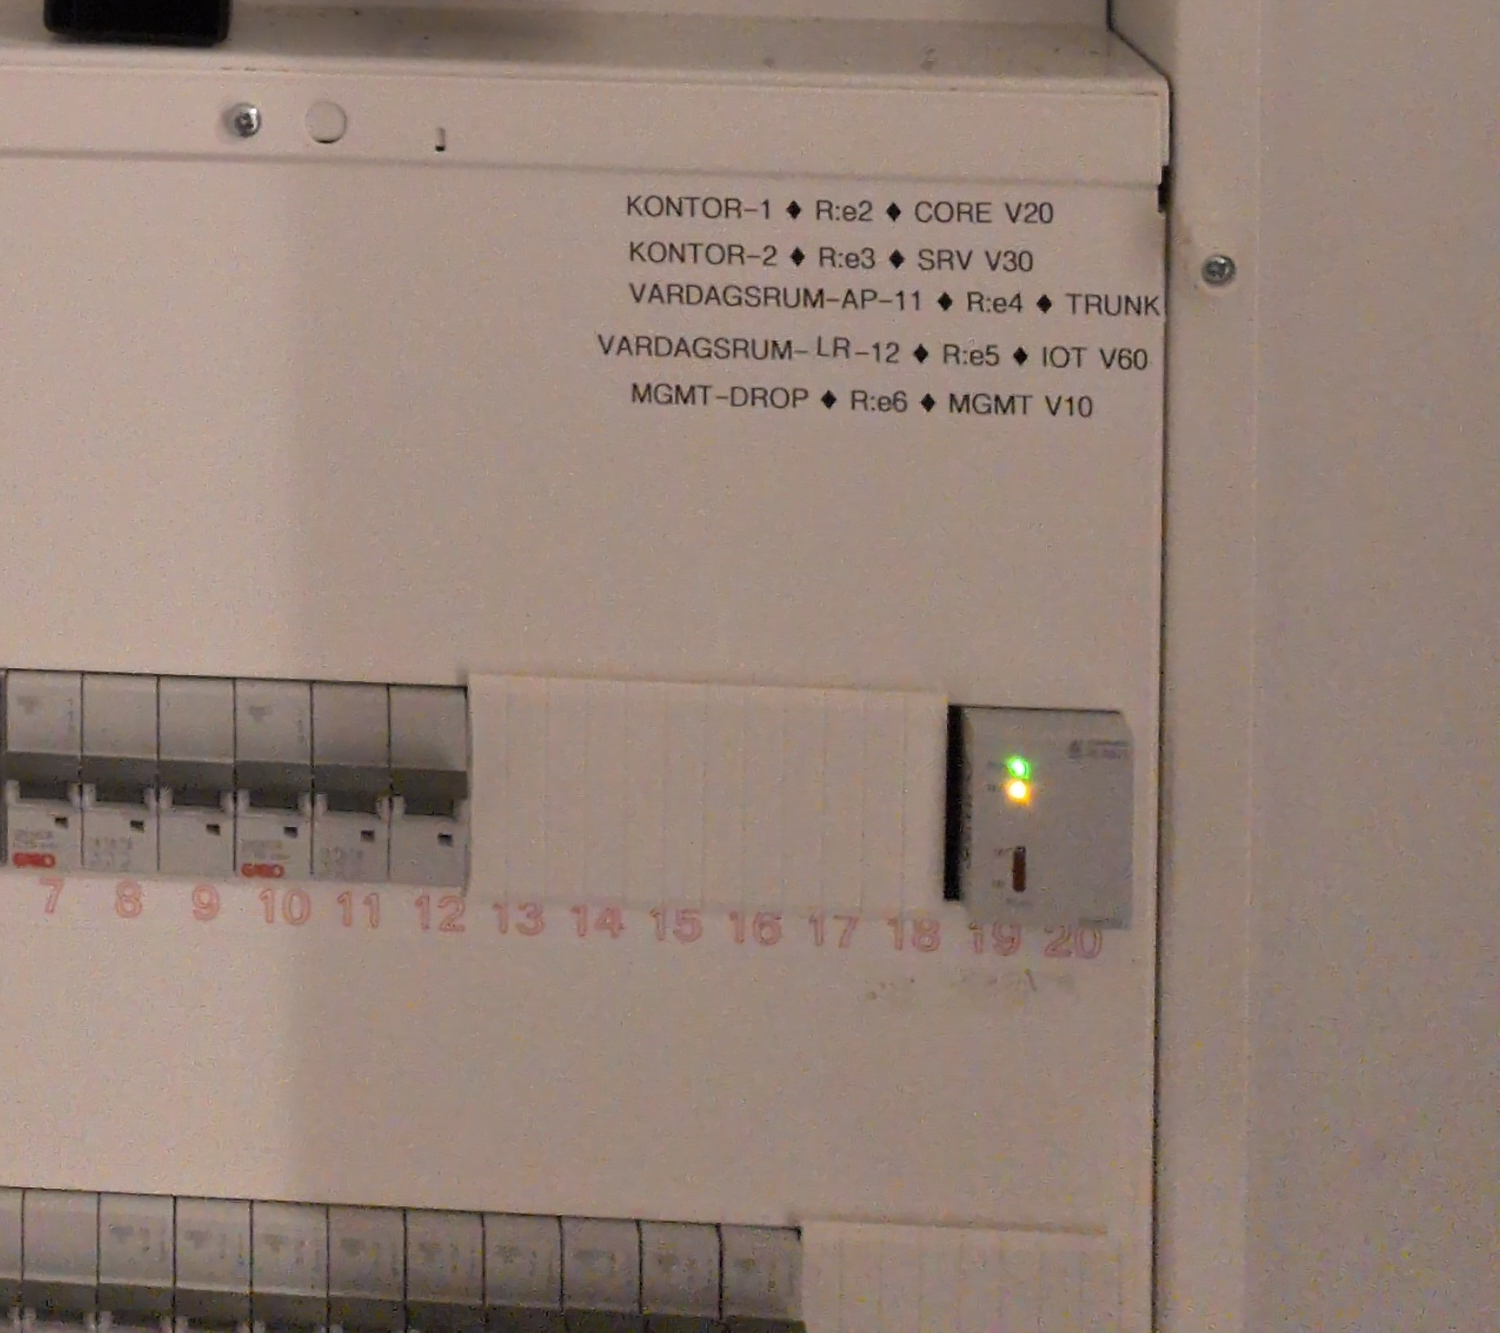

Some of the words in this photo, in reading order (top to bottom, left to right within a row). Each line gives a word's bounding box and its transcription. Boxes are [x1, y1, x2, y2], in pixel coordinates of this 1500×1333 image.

[626, 194, 770, 220] KONTOR-1
[815, 199, 873, 222] R:e2
[914, 200, 993, 224] CORE
[1004, 201, 1054, 224] V20
[629, 241, 778, 267] KONTOR-2
[819, 246, 876, 270] R:e3
[917, 248, 973, 271] SRV
[984, 250, 1034, 273] V30
[628, 283, 920, 311] VARDAGSRUM-AP-11
[966, 291, 1023, 314] R:e4
[1066, 293, 1160, 317] TRUNK
[943, 343, 1000, 367] R:e5
[1042, 345, 1087, 369] IOT
[1099, 347, 1148, 371] V60
[631, 382, 809, 410] MGMT-DROP
[851, 389, 908, 413] R:e6
[949, 392, 1033, 416] MGMT
[1044, 395, 1093, 418] V10
[39, 877, 65, 915] 7
[113, 881, 143, 919] 8
[192, 884, 221, 922] 9
[259, 888, 312, 926] 10
[337, 891, 382, 929] 11
[414, 894, 467, 933] 12
[492, 899, 545, 936] 13
[569, 902, 625, 940] 14
[649, 906, 704, 943] 15
[728, 909, 784, 946] 16
[808, 912, 861, 949] 17
[887, 915, 942, 953] 18
[967, 921, 1023, 956] 19
[1043, 924, 1102, 959] 20
